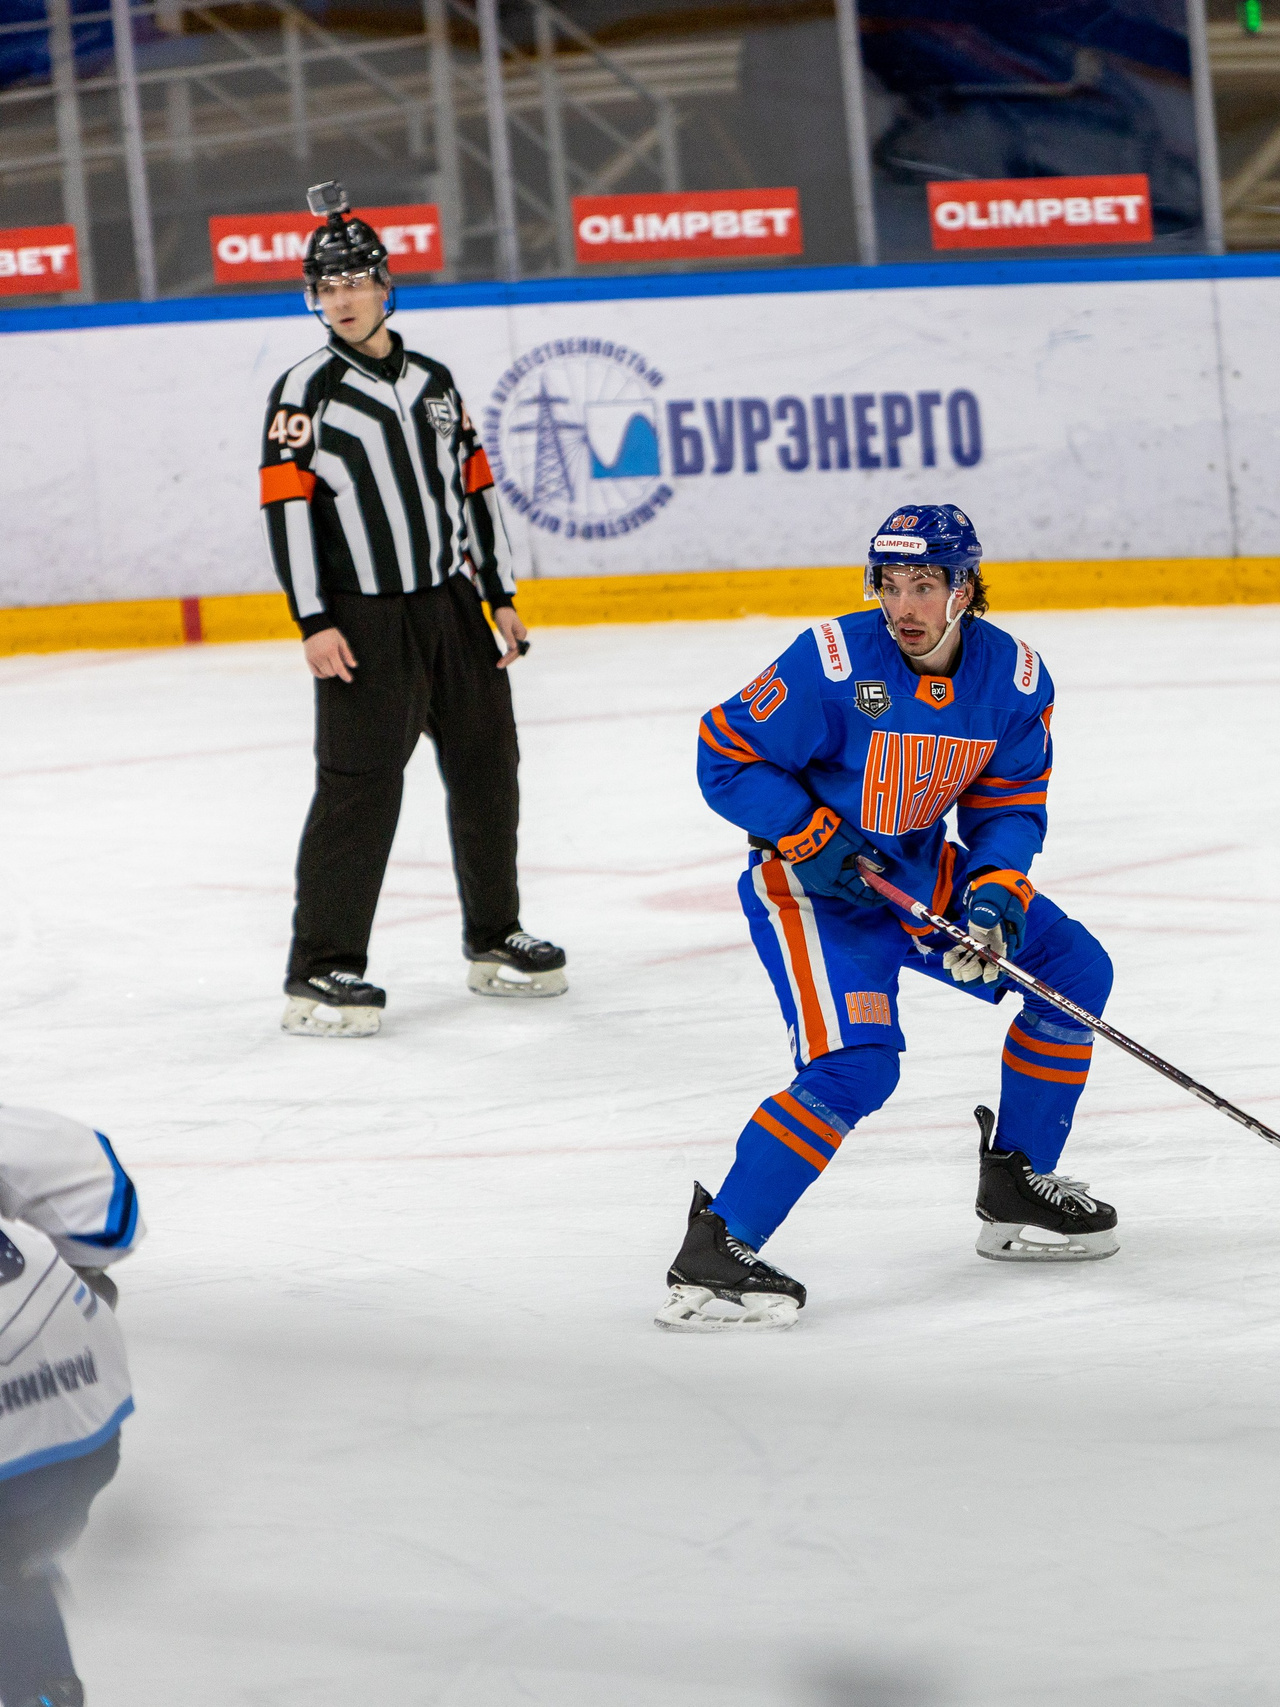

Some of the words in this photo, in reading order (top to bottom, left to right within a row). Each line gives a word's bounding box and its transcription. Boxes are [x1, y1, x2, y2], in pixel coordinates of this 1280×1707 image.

[579, 207, 795, 245] OLIMPBET
[934, 195, 1144, 231] OLIMPBET
[217, 223, 435, 264] OLIMET
[268, 409, 312, 448] 49
[665, 388, 983, 477] БУРЭНЕРГО
[876, 540, 922, 549] OLIMPBET
[931, 687, 946, 695] ВХЛ
[783, 815, 835, 862] CCM
[928, 913, 985, 951] CCM
[1048, 991, 1105, 1028] JETSPEED
